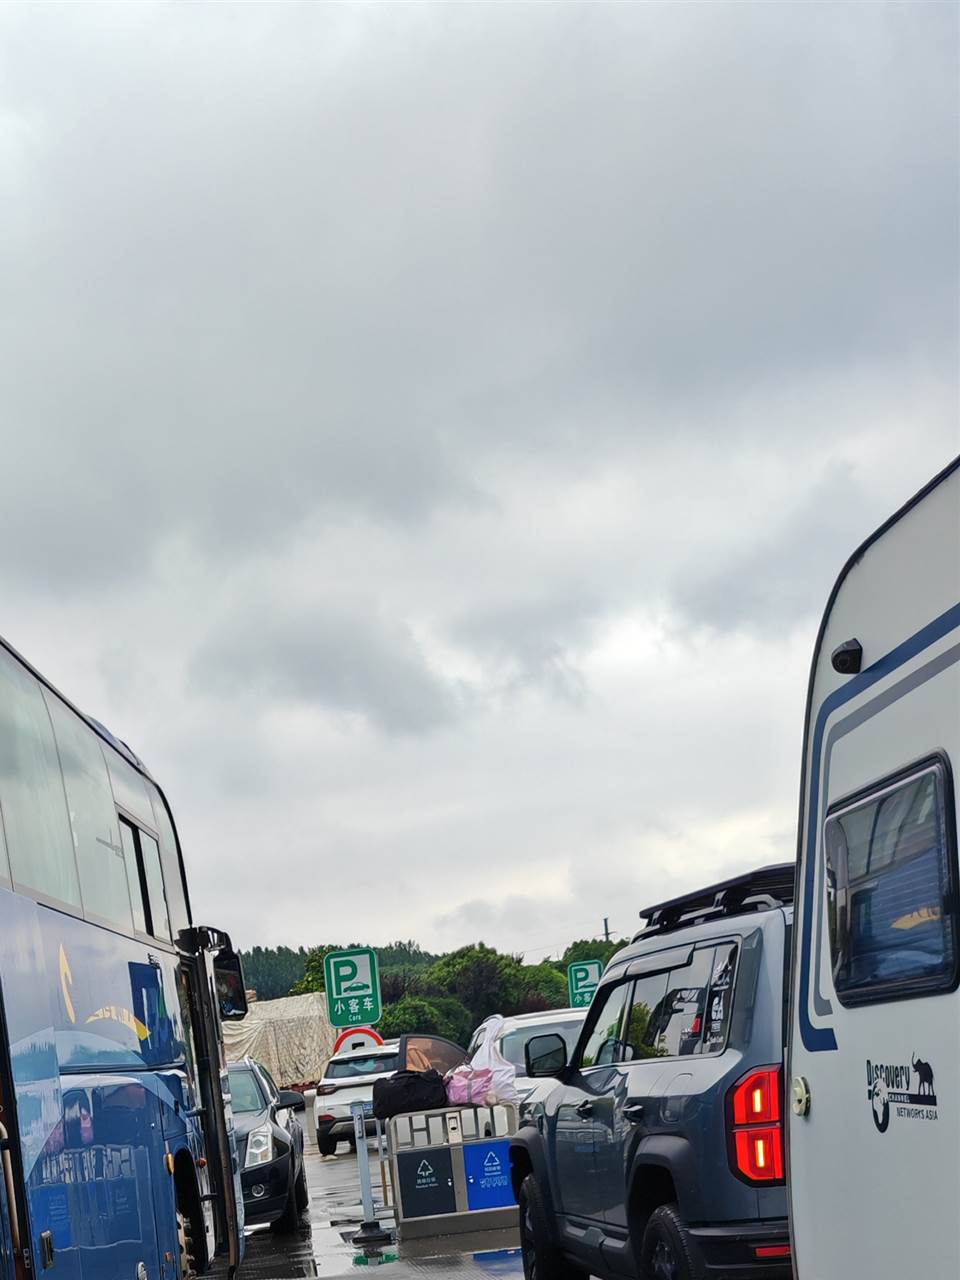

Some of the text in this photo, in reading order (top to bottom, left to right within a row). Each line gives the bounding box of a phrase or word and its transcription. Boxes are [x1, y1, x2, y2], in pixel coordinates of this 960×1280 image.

[333, 959, 357, 995] P
[334, 997, 374, 1015] 小客车
[896, 1107, 939, 1121] NETWORKS ASIA
